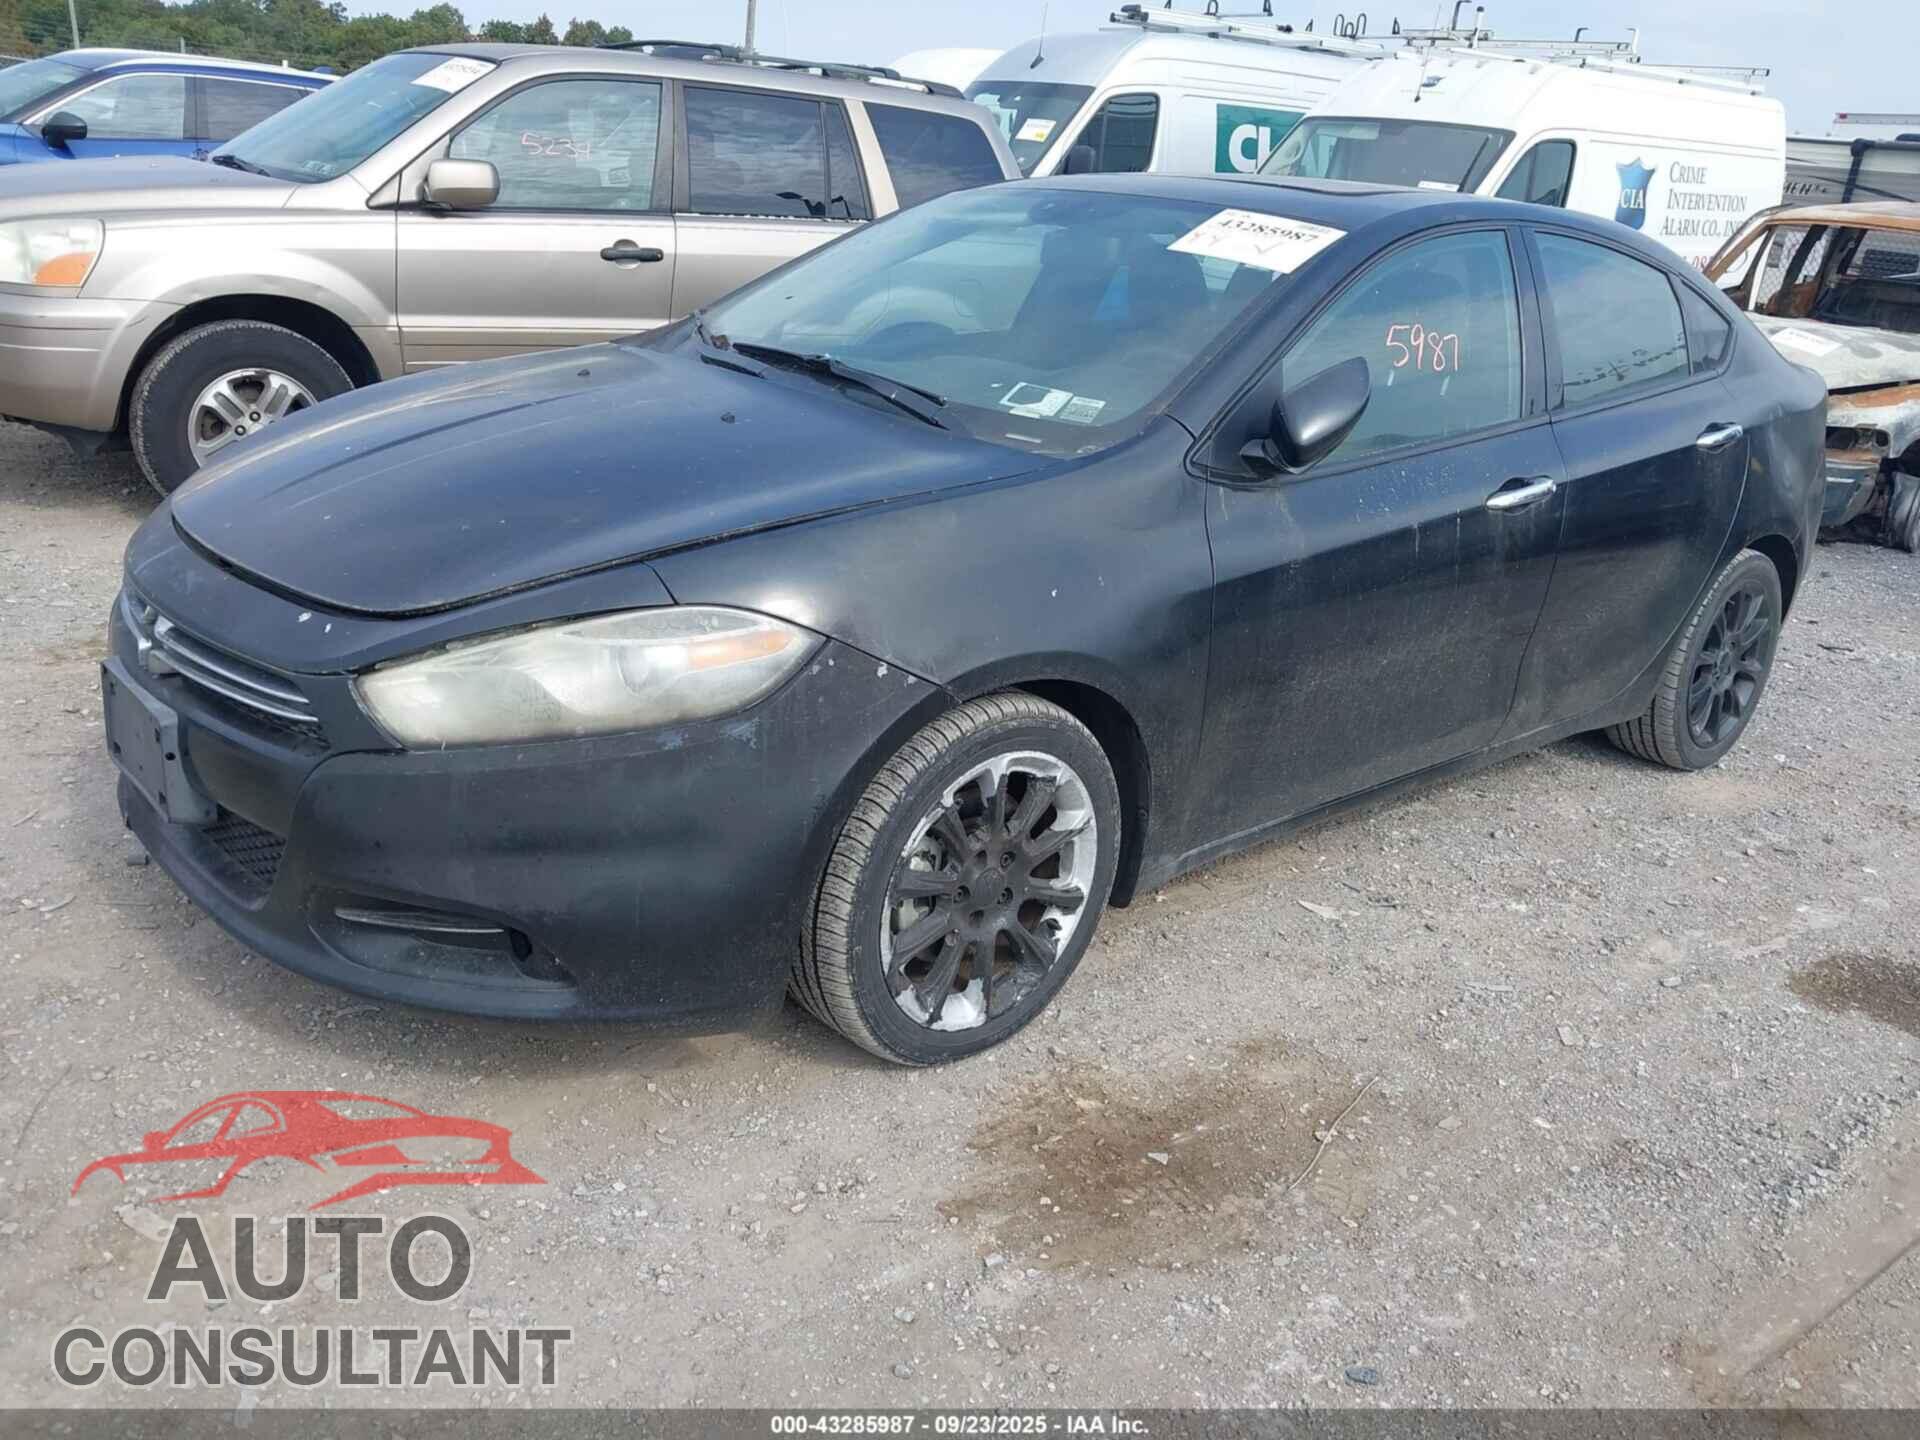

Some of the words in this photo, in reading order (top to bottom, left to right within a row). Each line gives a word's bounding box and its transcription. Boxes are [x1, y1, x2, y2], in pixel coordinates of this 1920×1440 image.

[521, 132, 590, 160] 5234
[1669, 160, 1707, 185] CRIME
[1620, 188, 1644, 209] CIA
[1667, 187, 1748, 213] INTERVENTION
[1660, 215, 1700, 237] ALARM
[1386, 323, 1458, 371] 5987
